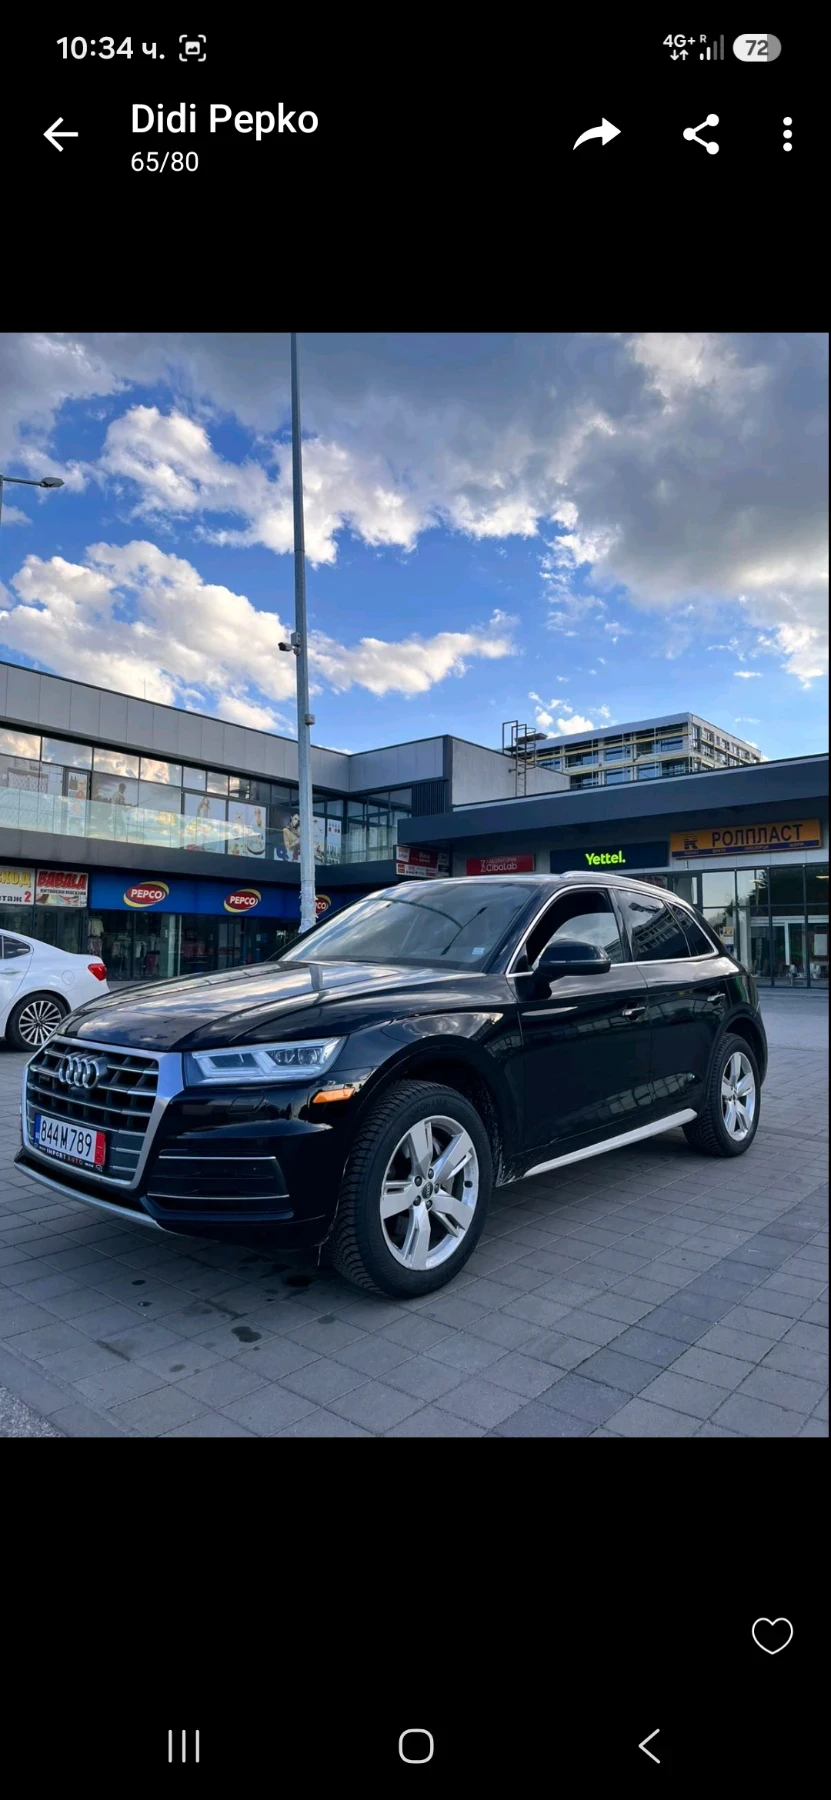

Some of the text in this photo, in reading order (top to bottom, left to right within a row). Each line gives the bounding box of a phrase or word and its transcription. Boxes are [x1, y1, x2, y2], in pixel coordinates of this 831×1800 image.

[711, 823, 803, 847] РОЛПЛАСТ
[585, 850, 626, 866] Yettel.
[24, 890, 32, 903] 2
[130, 888, 163, 900] PEPCO
[229, 895, 256, 906] PEPCO
[40, 1119, 93, 1157] 844M789
